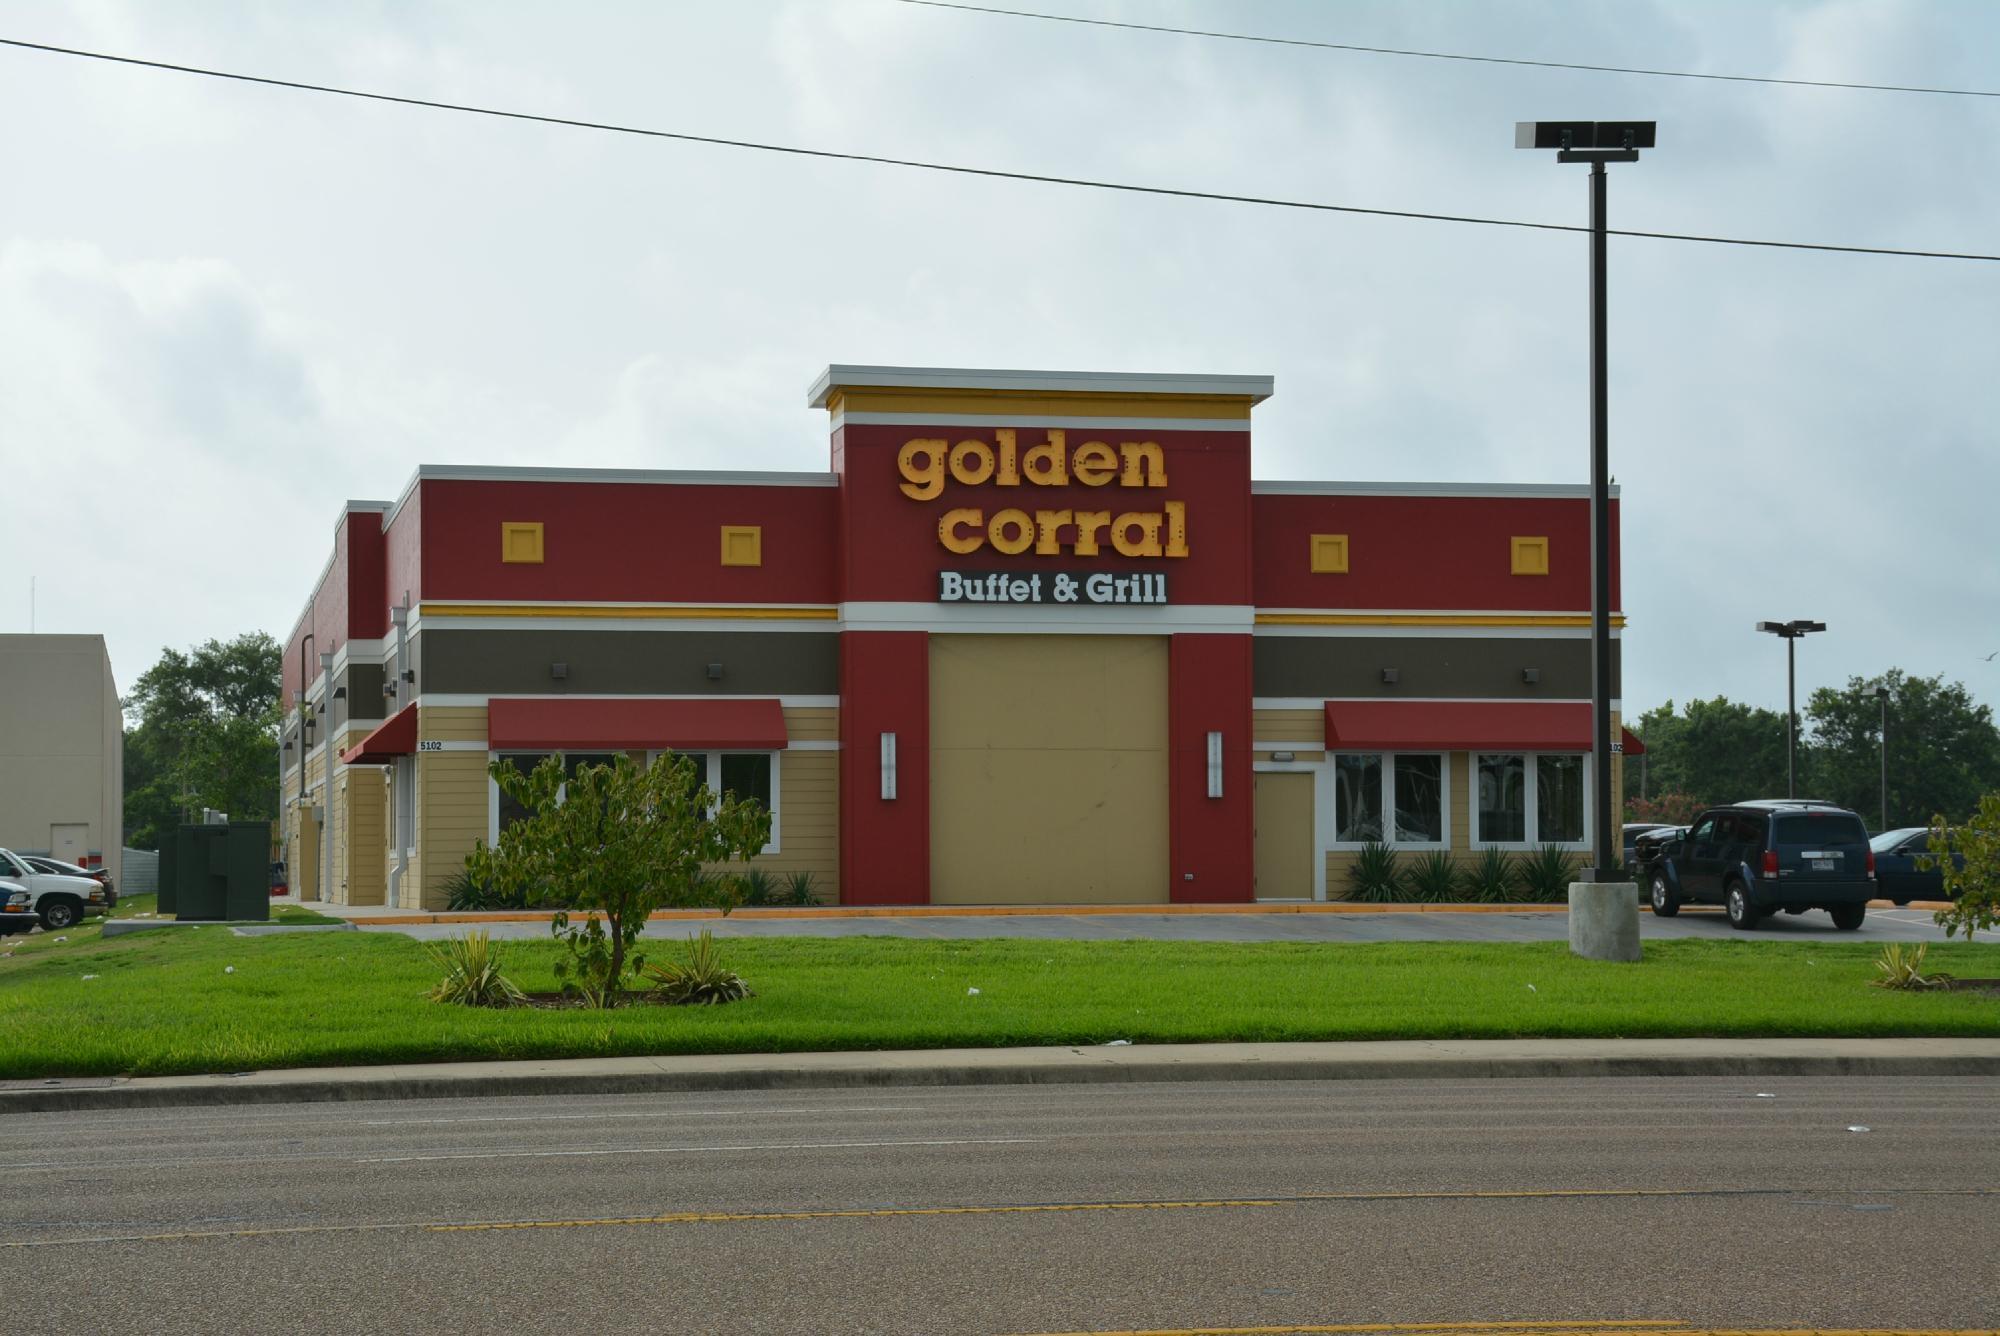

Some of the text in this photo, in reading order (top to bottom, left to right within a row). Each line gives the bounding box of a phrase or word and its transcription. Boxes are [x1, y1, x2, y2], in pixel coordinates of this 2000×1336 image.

[898, 429, 1167, 501] golden
[939, 501, 1189, 557] corral
[941, 572, 1167, 603] Buffet & Grill
[420, 741, 442, 750] 5102
